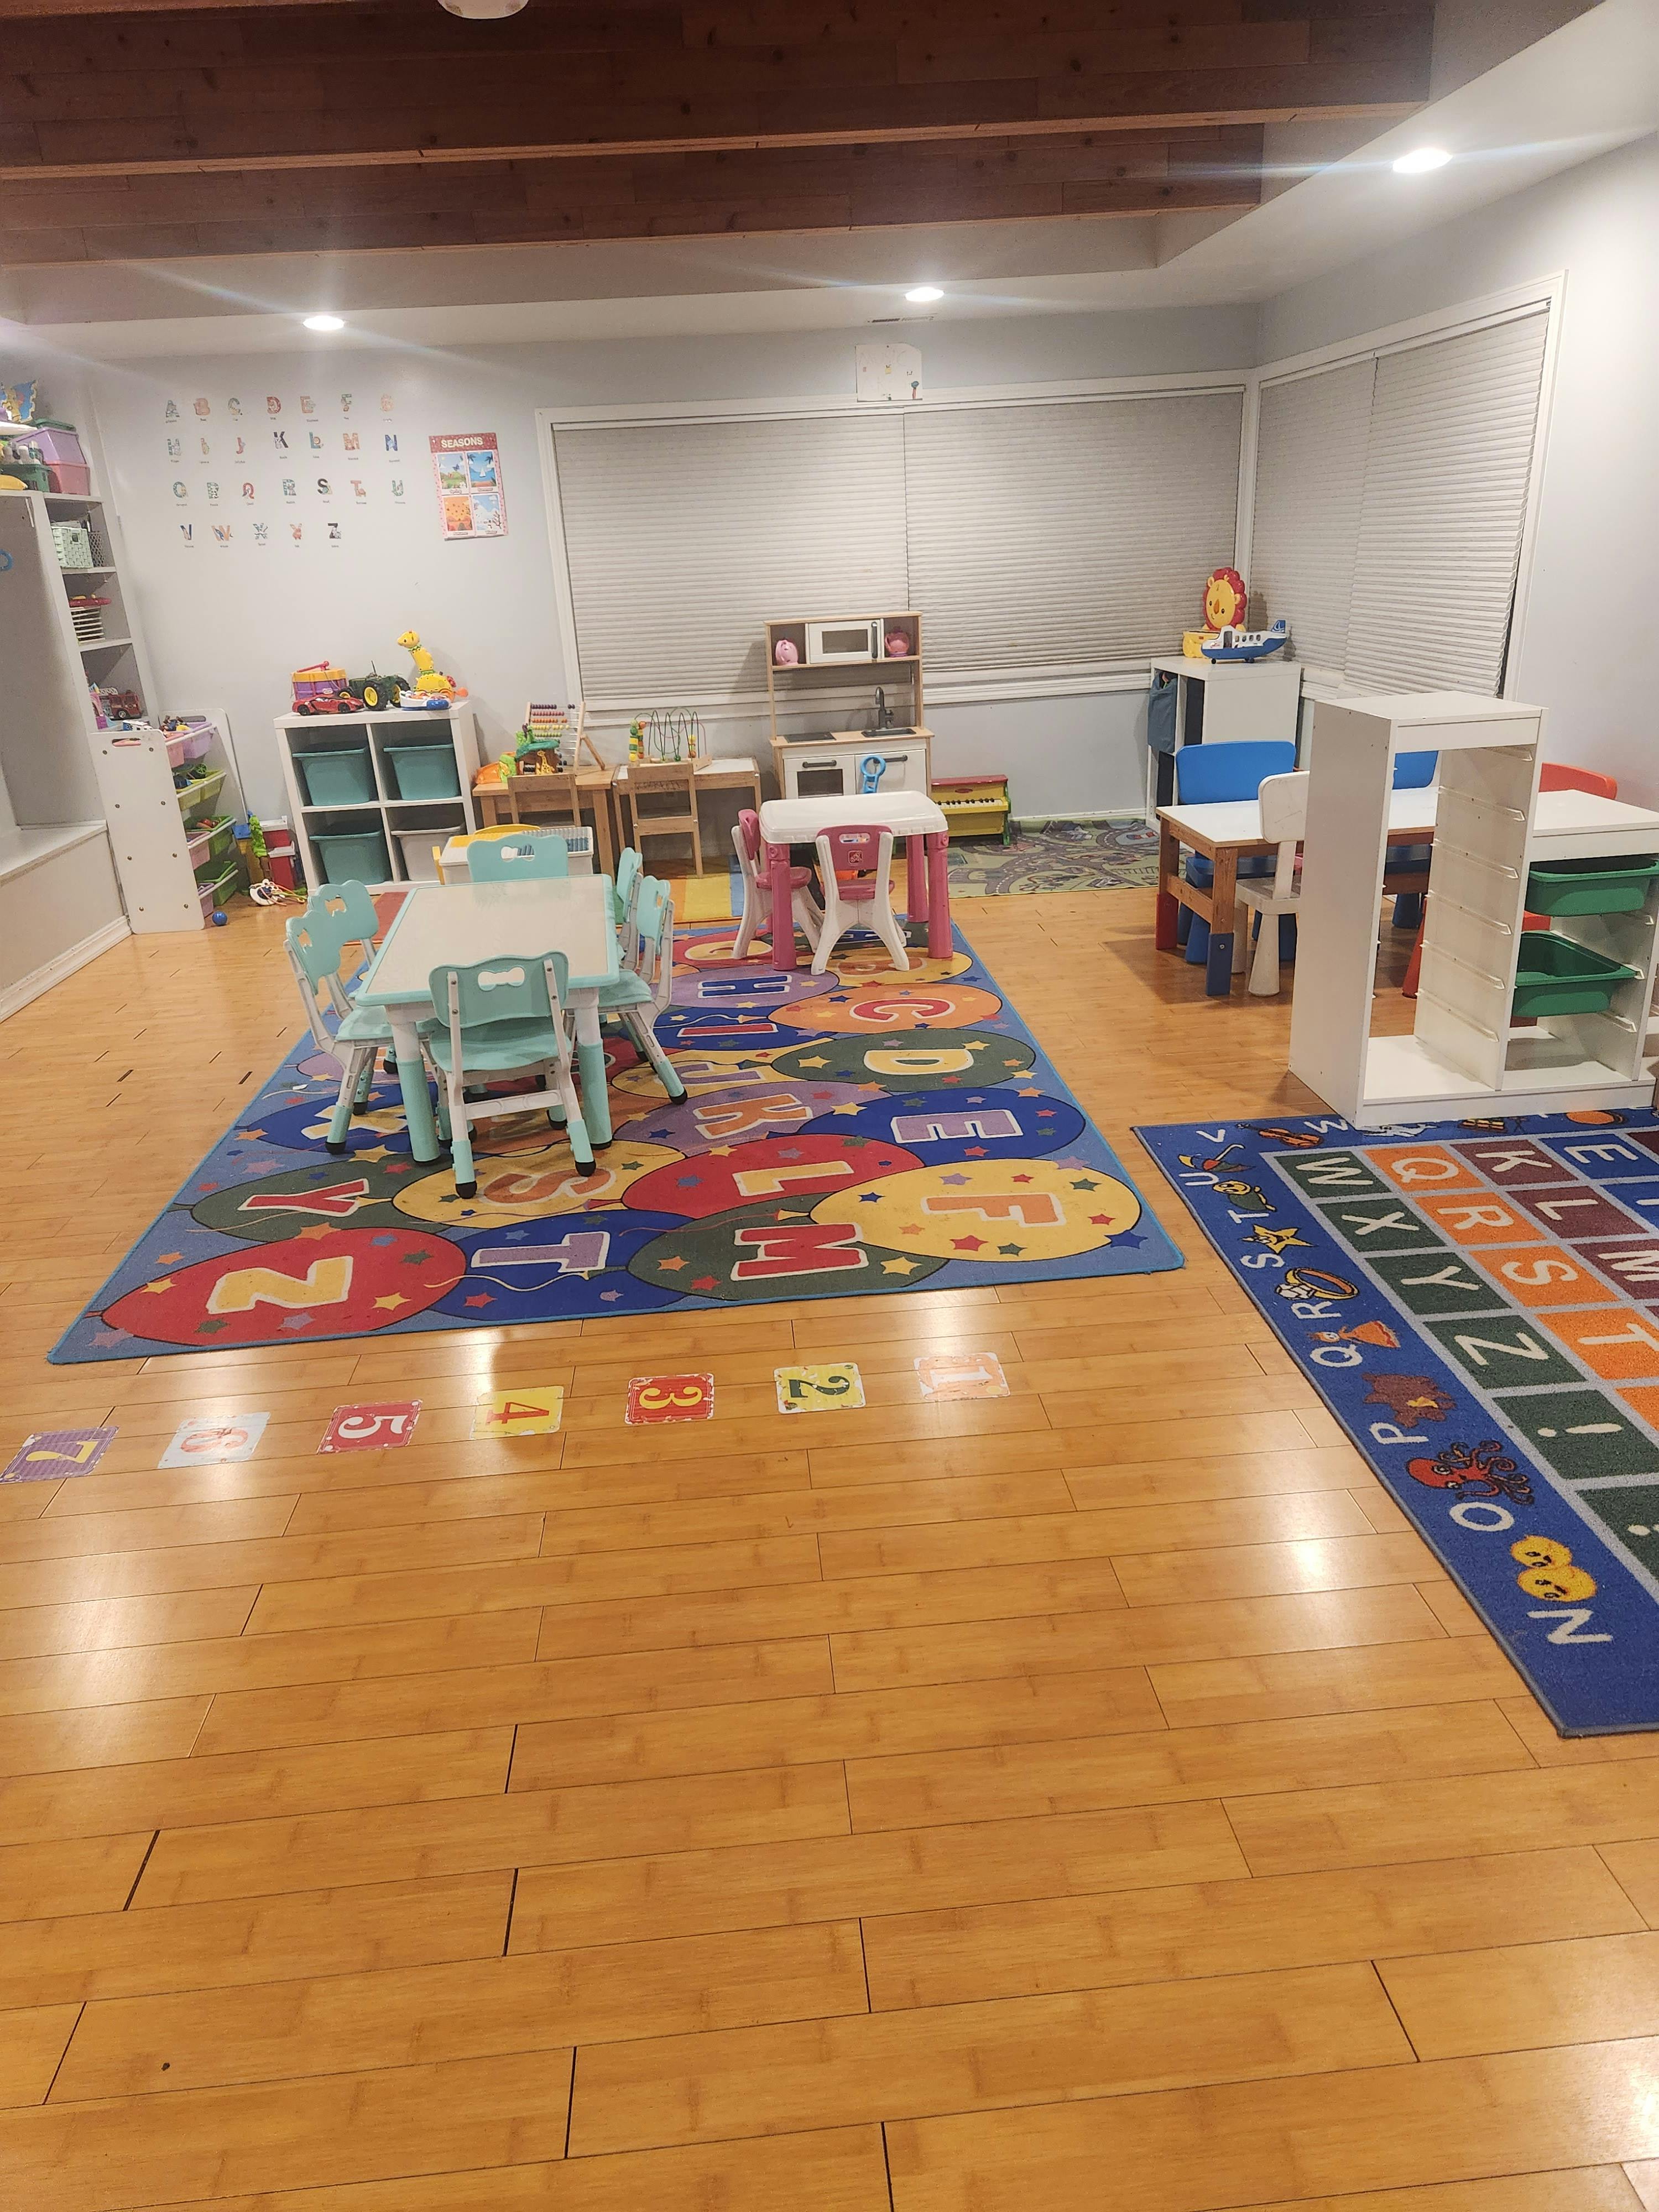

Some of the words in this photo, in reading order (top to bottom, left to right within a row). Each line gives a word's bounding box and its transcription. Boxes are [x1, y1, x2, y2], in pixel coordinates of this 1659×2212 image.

[267, 396, 281, 414] D
[274, 431, 289, 449] K
[309, 432, 322, 449] L
[385, 435, 398, 451] N
[441, 437, 483, 448] SEASONS
[317, 478, 332, 494] S
[698, 974, 791, 999] H
[849, 997, 956, 1021] C
[864, 1048, 973, 1076] D
[693, 1093, 813, 1140] K
[891, 1109, 1022, 1144] E
[1475, 1150, 1552, 1172] K
[1564, 1144, 1639, 1164] E
[732, 1161, 855, 1198] L
[1178, 1172, 1220, 1186] U
[1296, 1157, 1374, 1186] W
[1391, 1157, 1459, 1182] Q
[238, 1178, 369, 1216] Y
[477, 1166, 617, 1204] S
[921, 1192, 1066, 1227] F
[1227, 1209, 1270, 1224] T
[1437, 1205, 1514, 1230] R
[1535, 1199, 1599, 1220] L
[1342, 1211, 1420, 1235] X
[471, 1230, 610, 1274] T
[730, 1223, 869, 1281] M
[1240, 1253, 1285, 1269] S
[206, 1255, 353, 1314] Z
[1401, 1266, 1479, 1290] Y
[1500, 1260, 1579, 1285] S
[1291, 1301, 1342, 1320] R
[1310, 1344, 1363, 1368] Q
[1455, 1332, 1550, 1366] Z
[639, 1386, 703, 1409] 3
[787, 1375, 851, 1399] 2
[486, 1402, 550, 1425] 4
[338, 1415, 409, 1439] 5
[1369, 1422, 1428, 1445] P
[25, 1441, 98, 1463] 7
[1449, 1502, 1515, 1532] O
[1526, 1609, 1614, 1645] N
